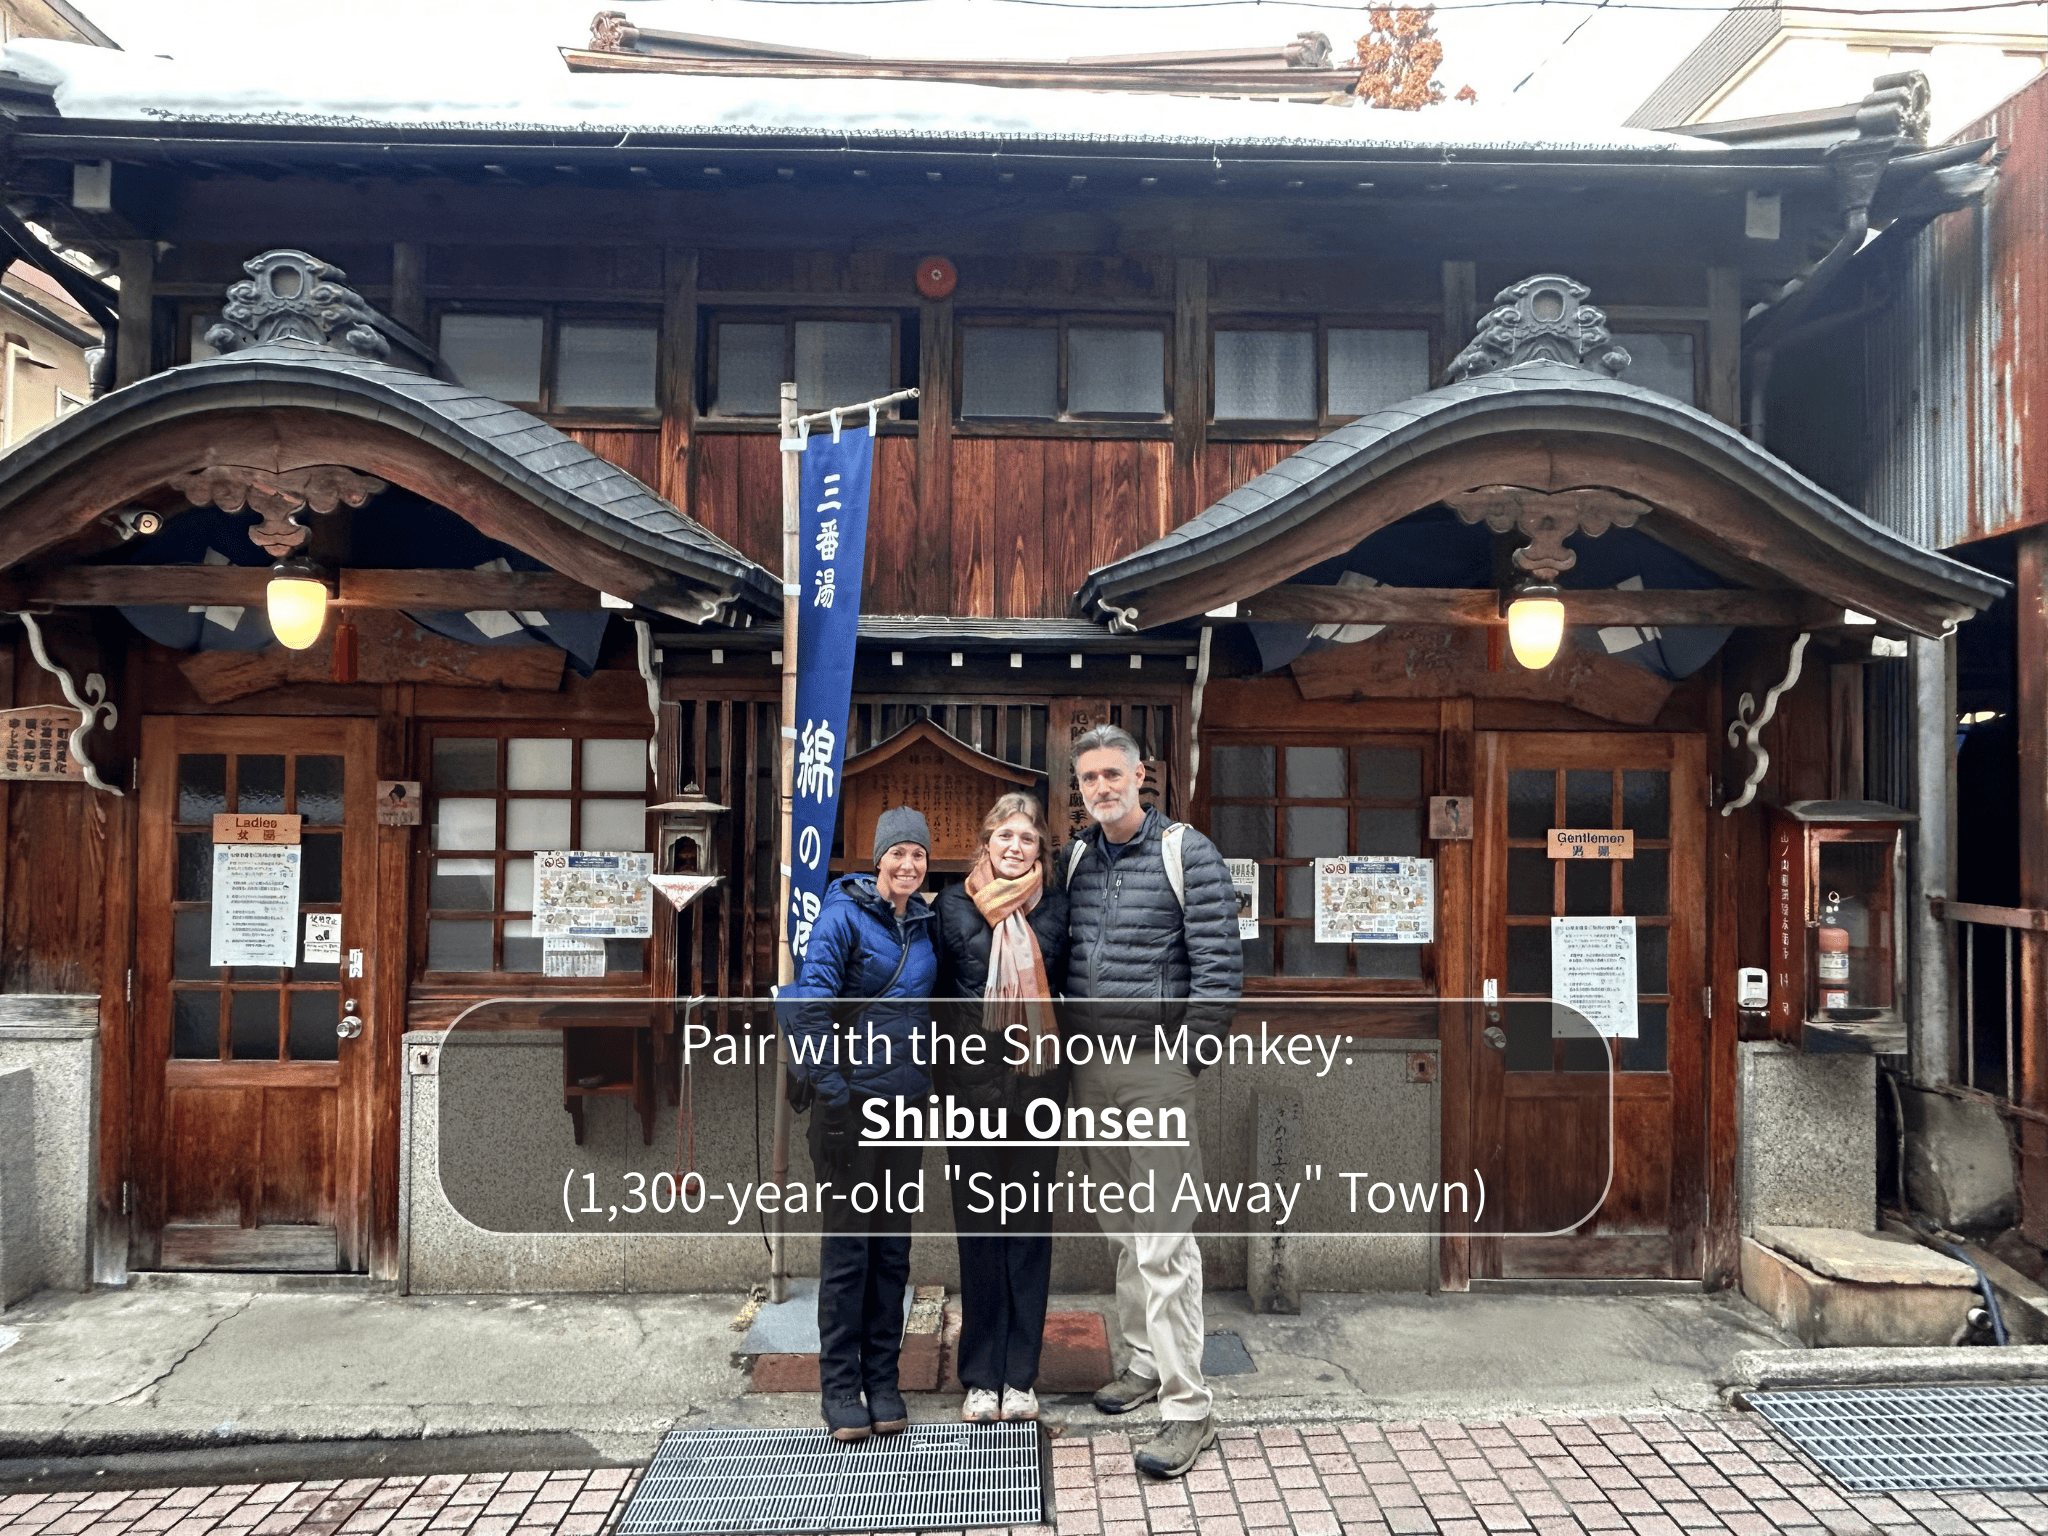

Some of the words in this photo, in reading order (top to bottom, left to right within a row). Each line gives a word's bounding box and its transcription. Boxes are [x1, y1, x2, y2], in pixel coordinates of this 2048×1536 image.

[814, 474, 842, 609] 三番湯
[235, 816, 278, 828] Ladies
[1557, 832, 1625, 844] Gentlemen
